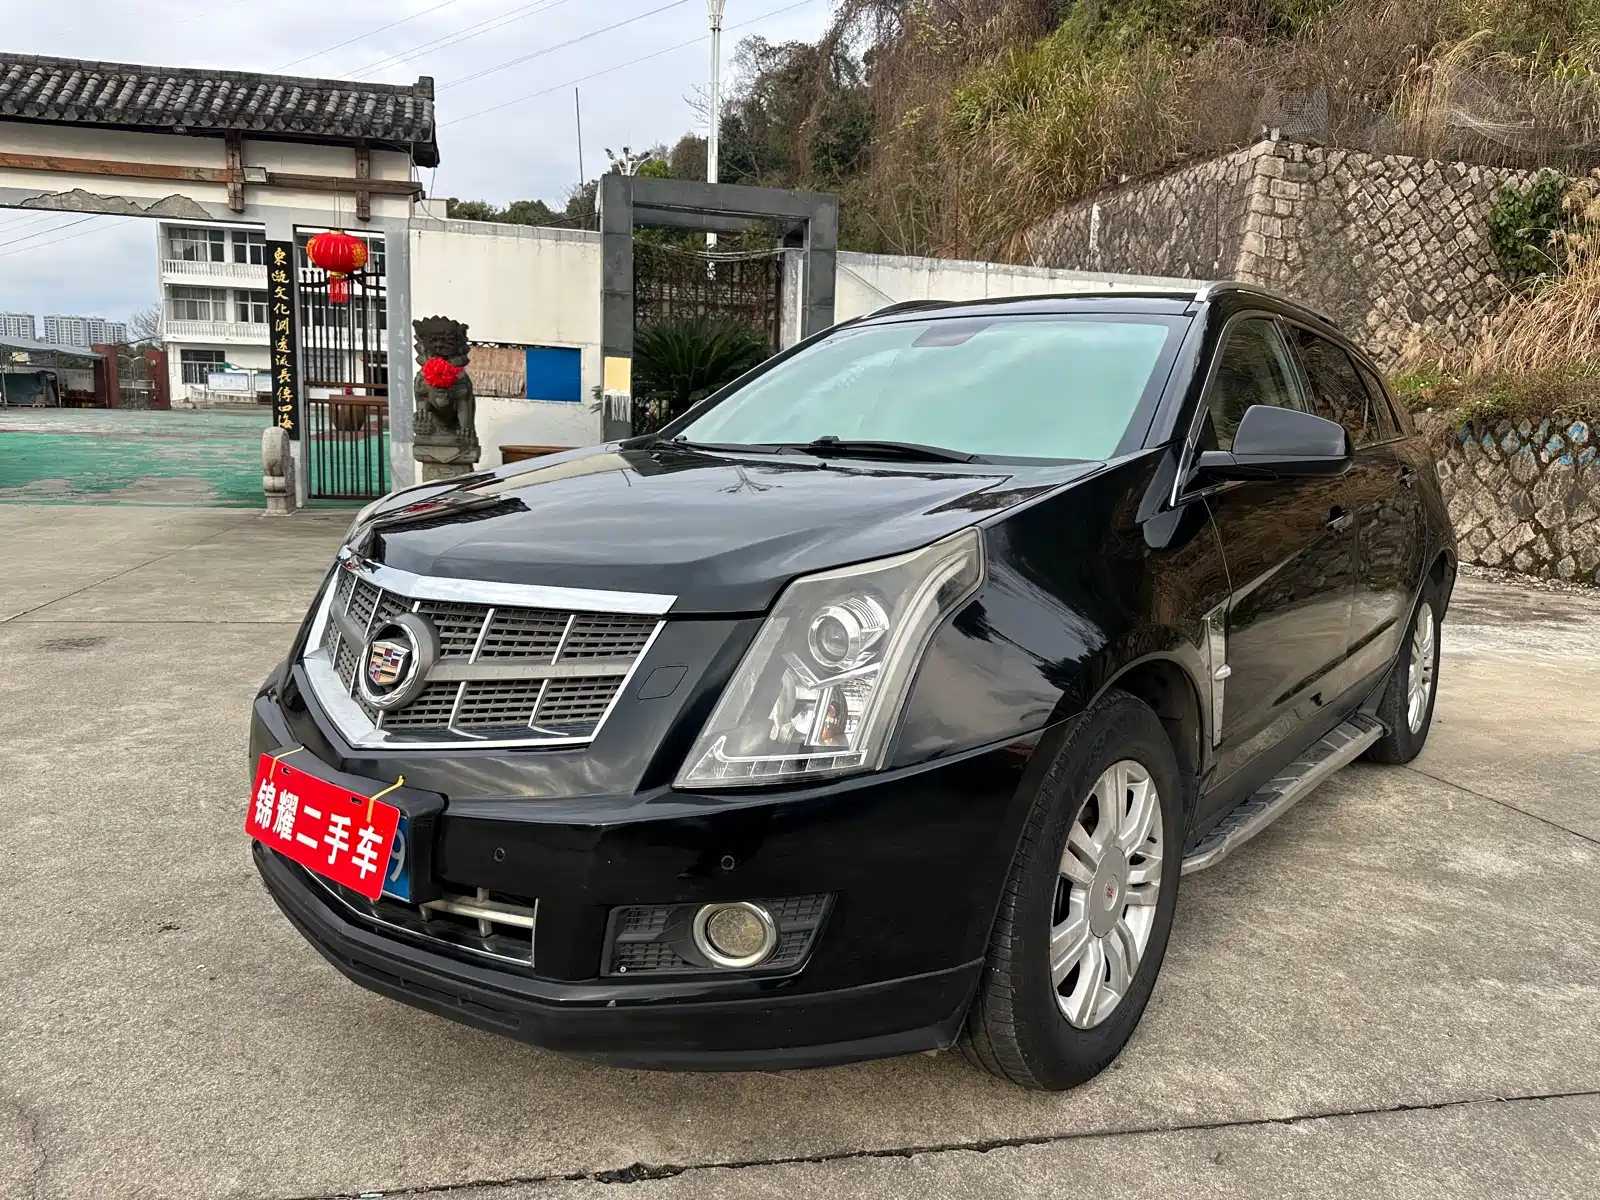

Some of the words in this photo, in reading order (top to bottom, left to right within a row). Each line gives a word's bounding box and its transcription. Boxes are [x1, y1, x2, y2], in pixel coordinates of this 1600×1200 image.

[254, 777, 384, 880] 锦耀二手车
